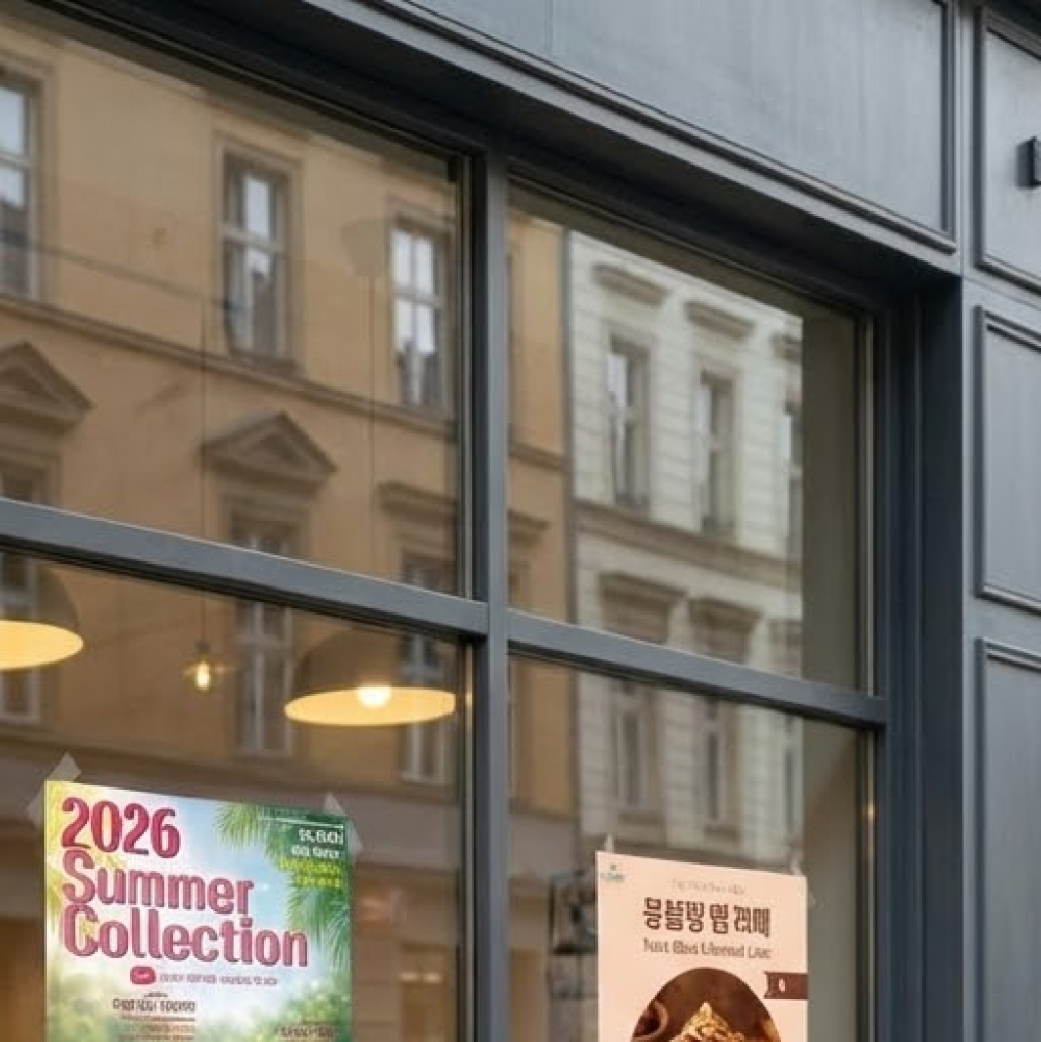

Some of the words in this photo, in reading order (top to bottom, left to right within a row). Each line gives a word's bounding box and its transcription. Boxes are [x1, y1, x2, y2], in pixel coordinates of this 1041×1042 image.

[61, 796, 182, 859] 2026
[61, 850, 255, 916] Summer
[63, 903, 309, 968] Collection
